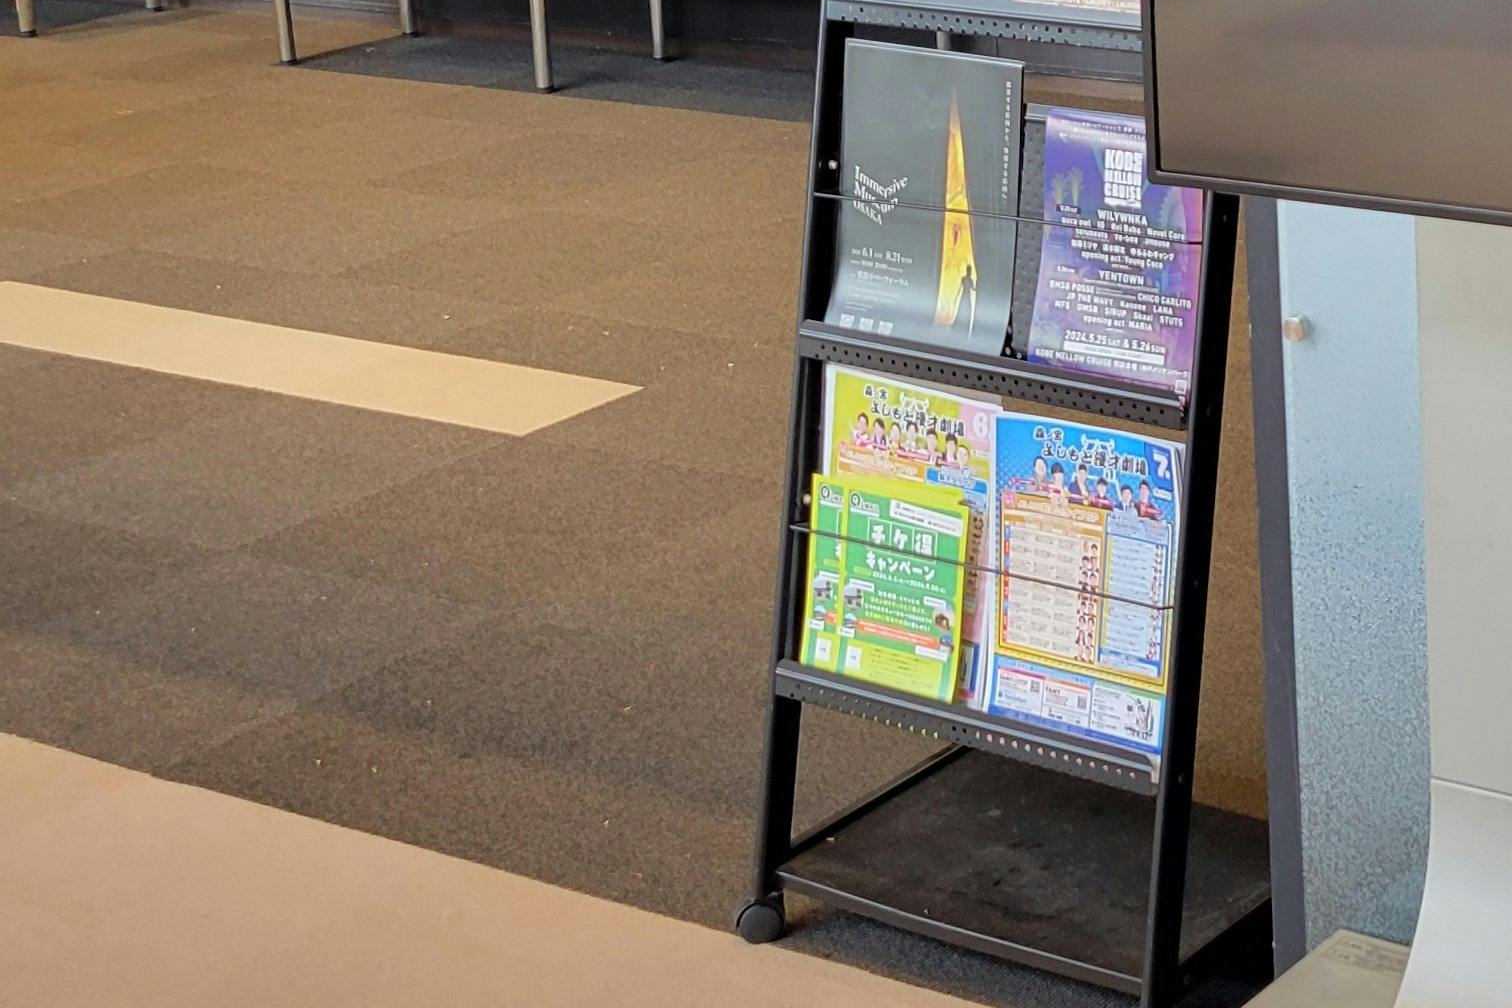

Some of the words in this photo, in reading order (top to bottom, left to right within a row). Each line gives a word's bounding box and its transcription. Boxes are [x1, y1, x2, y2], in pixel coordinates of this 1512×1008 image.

[1105, 149, 1143, 172] KOBE
[855, 164, 908, 198] Immersive
[1098, 209, 1147, 226] WILYWNKA
[1099, 270, 1145, 285] YENTOWN
[1078, 293, 1092, 302] THE
[871, 401, 965, 436] よしもと漫才劇場
[1043, 444, 1147, 476] よしもと漫才劇場
[866, 551, 935, 580] キャンペーン
